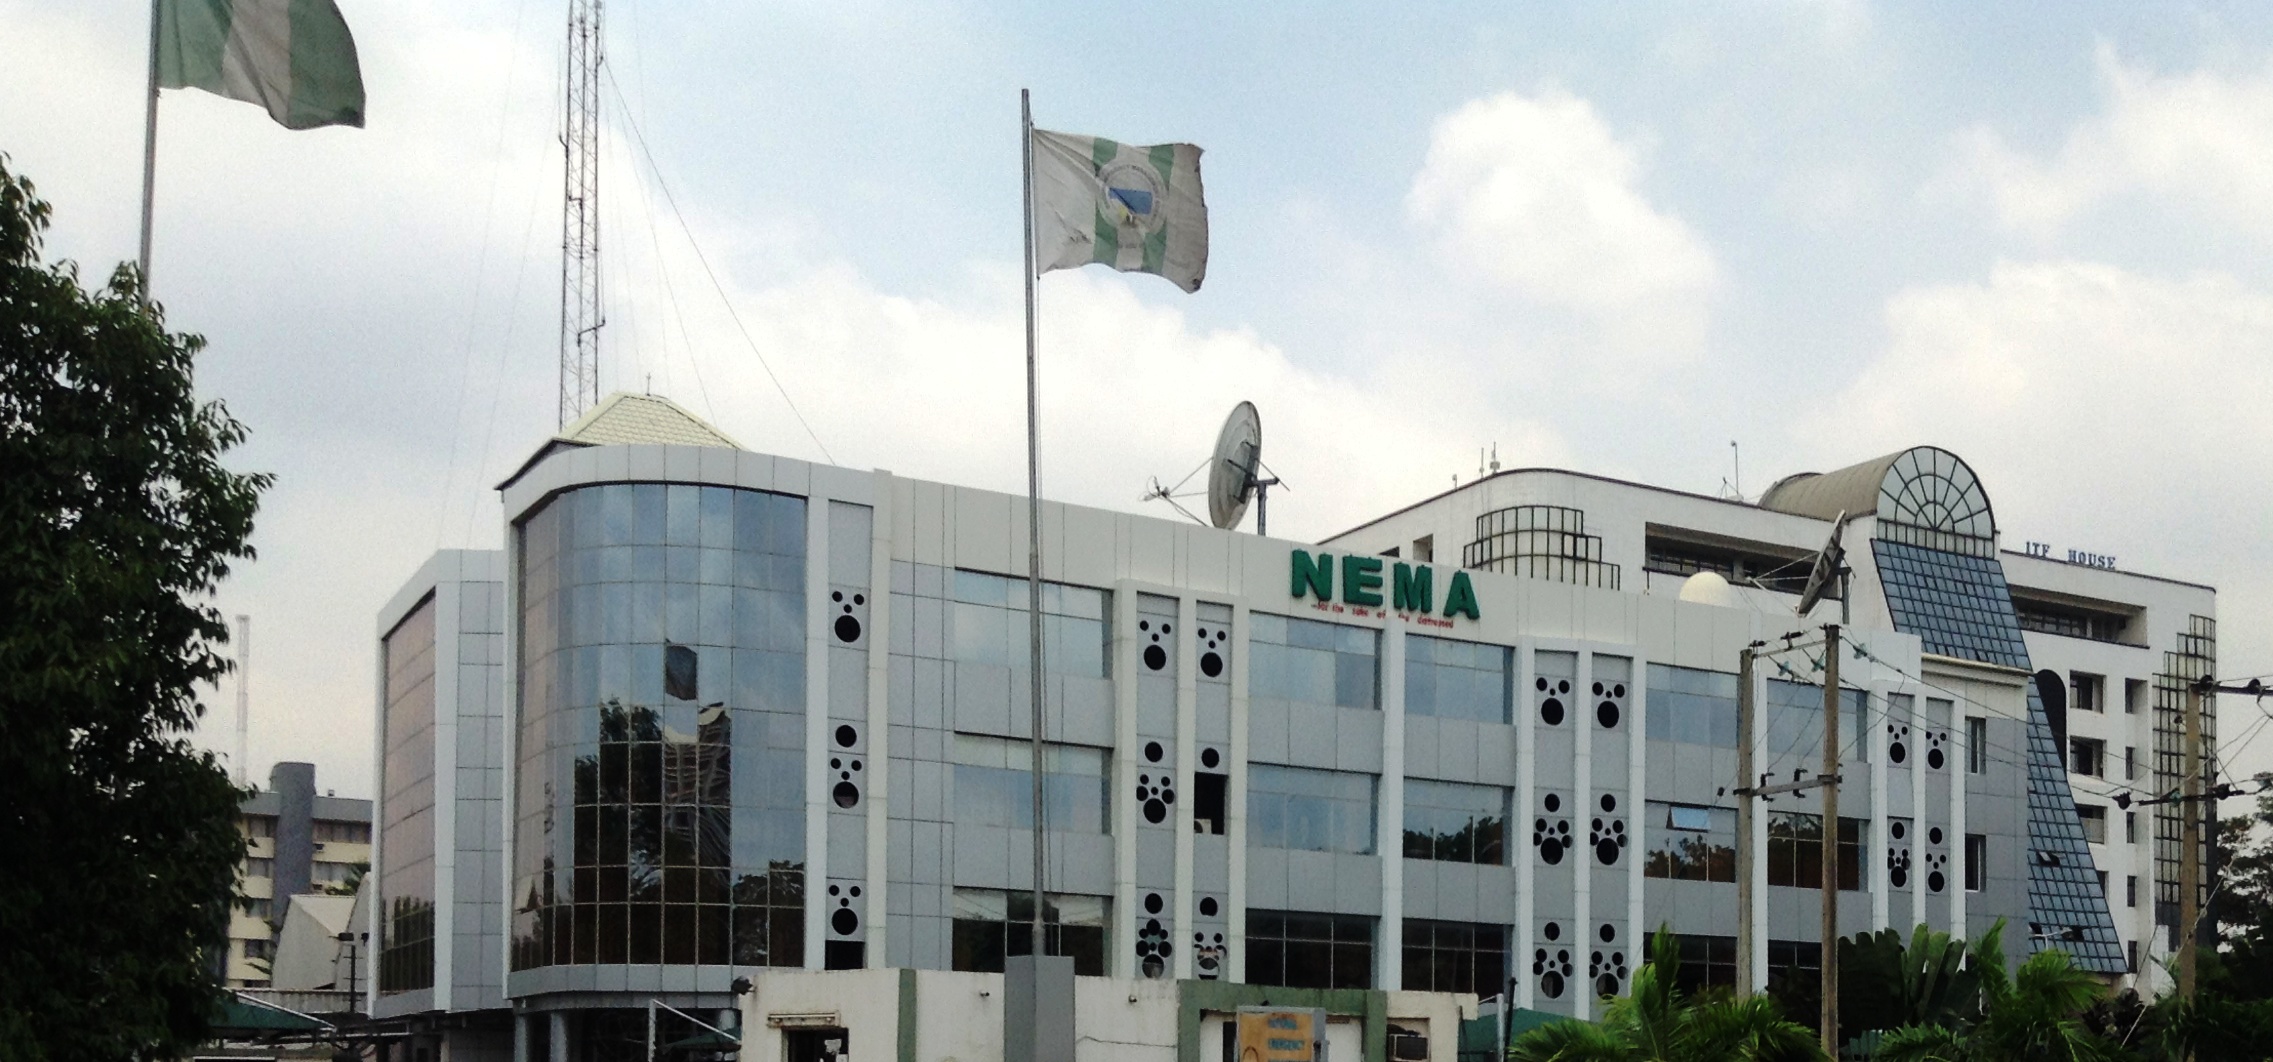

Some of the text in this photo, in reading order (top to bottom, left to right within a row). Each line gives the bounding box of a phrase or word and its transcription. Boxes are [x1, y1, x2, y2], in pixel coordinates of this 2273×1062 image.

[2025, 541, 2116, 570] ITF HOUSE
[1291, 548, 1480, 620] NEMA
